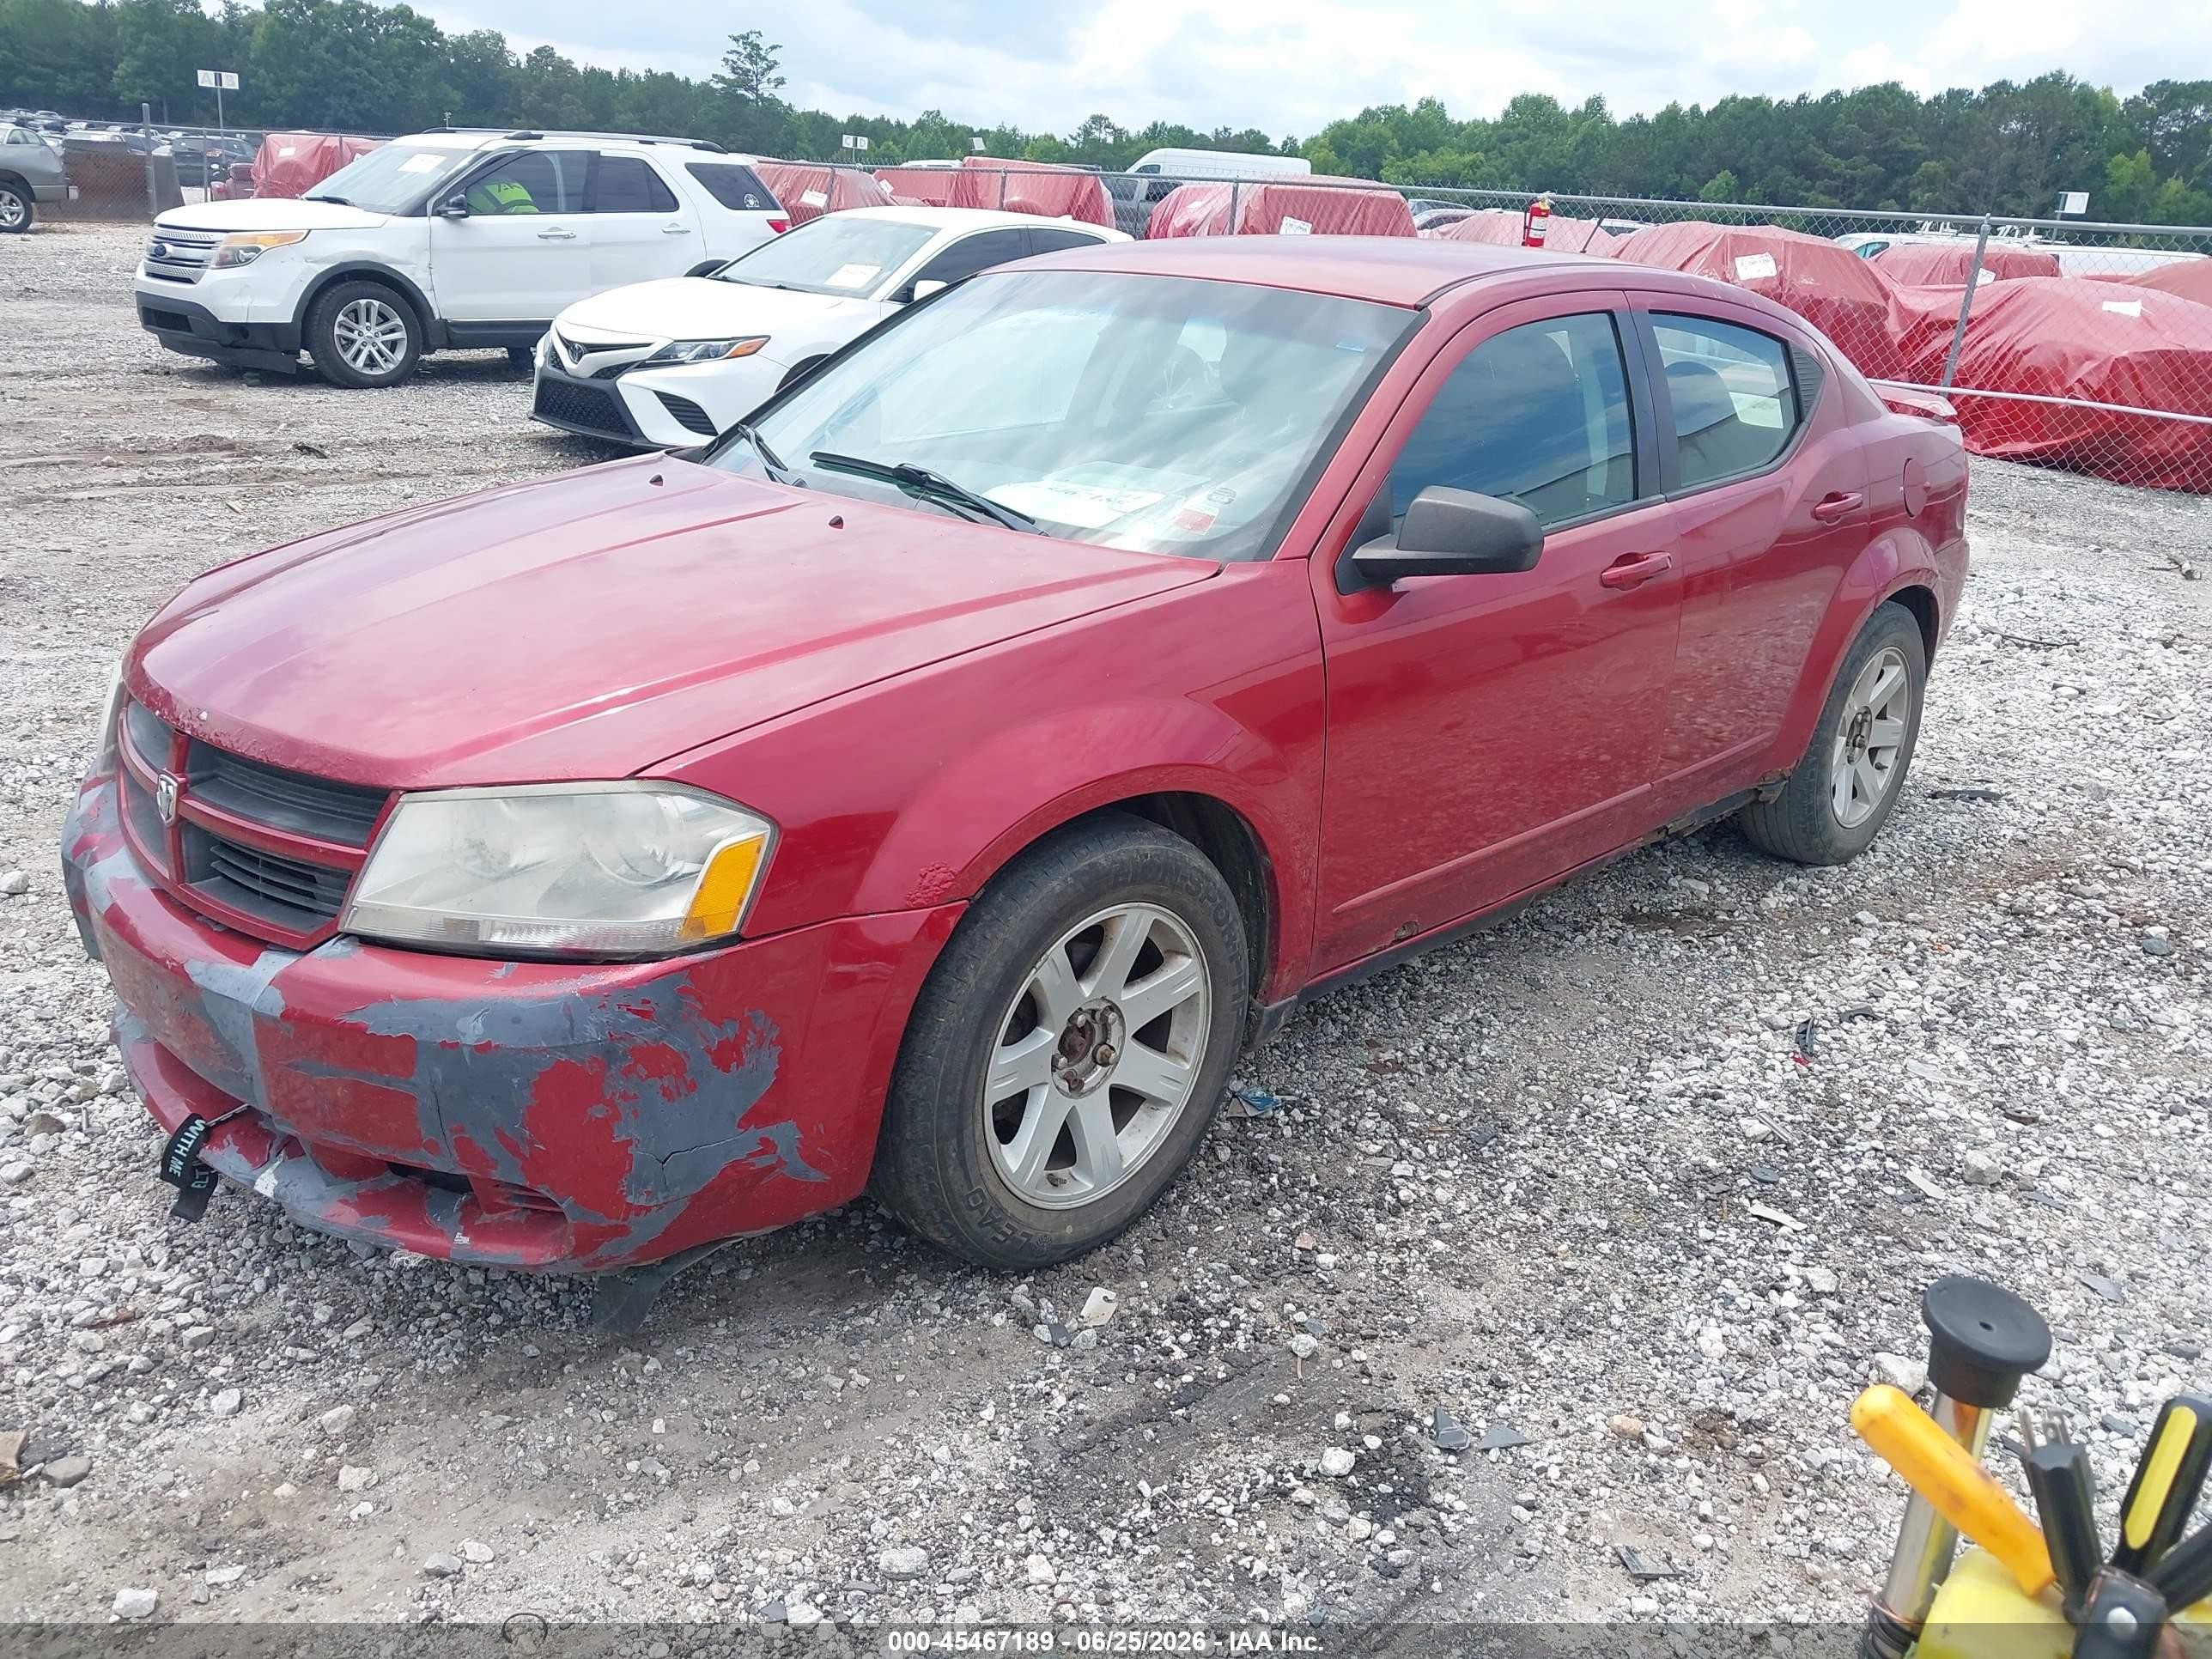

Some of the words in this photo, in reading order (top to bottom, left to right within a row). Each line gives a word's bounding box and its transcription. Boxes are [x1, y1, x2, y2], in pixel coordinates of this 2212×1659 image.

[200, 72, 214, 85] A
[860, 138, 866, 147] D
[174, 1119, 206, 1157] WITH
[168, 1156, 184, 1177] ME
[964, 1188, 1034, 1250] LEAO
